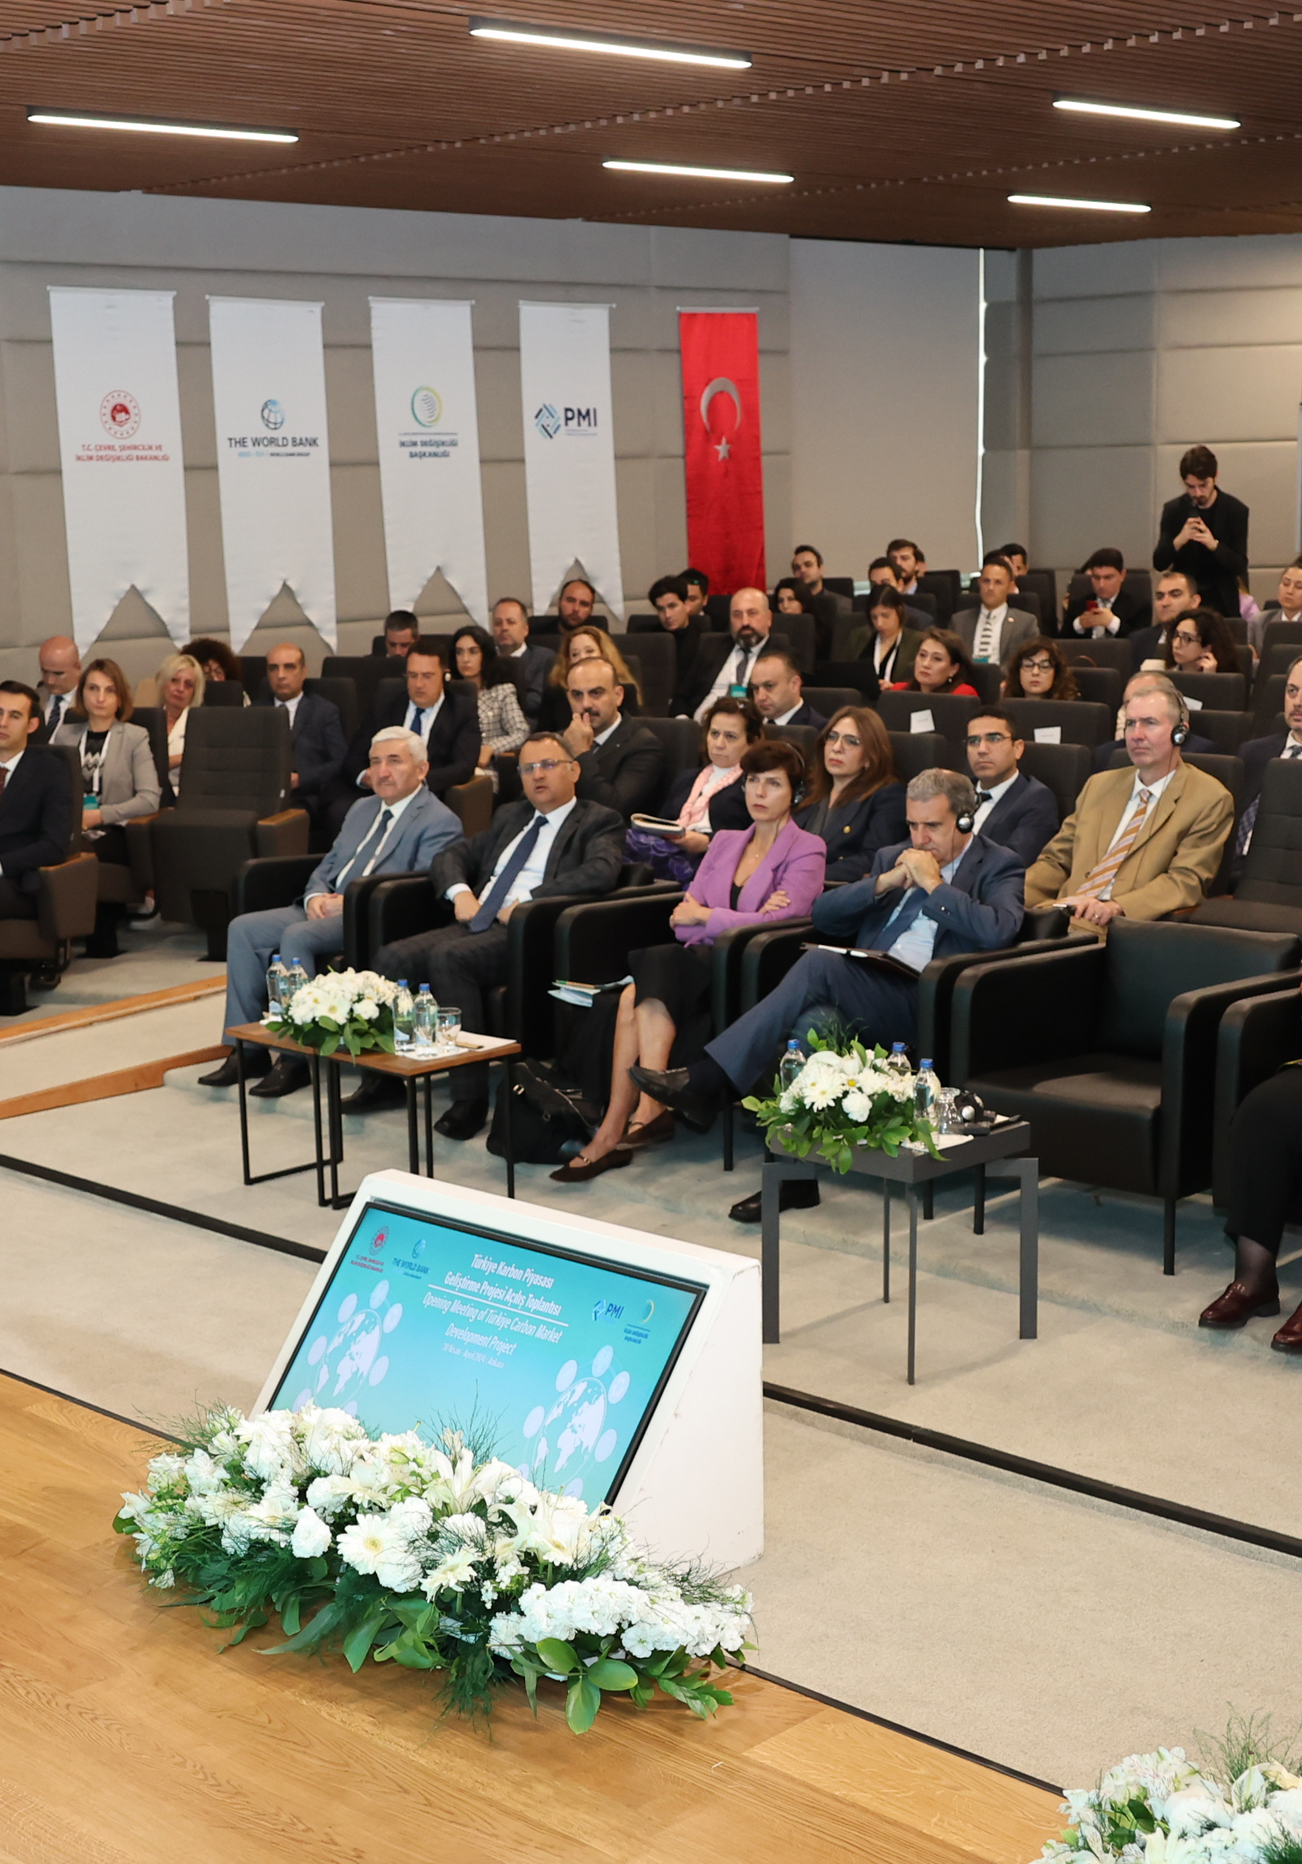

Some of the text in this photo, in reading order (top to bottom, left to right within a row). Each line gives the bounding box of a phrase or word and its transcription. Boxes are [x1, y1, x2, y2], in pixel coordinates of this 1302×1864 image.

[564, 407, 597, 427] PMI
[227, 436, 319, 448] THE WORLD BANK
[415, 1264, 430, 1275] BANK
[471, 1253, 555, 1289] Türkiye Karbon Piyasası
[444, 1271, 562, 1316] Geliştirme Projesi Açılış Toplantısı
[422, 1291, 564, 1343] Opening Meeting of Türkiye Carbon Market
[605, 1303, 624, 1319] PMI
[445, 1322, 518, 1356] Development Project
